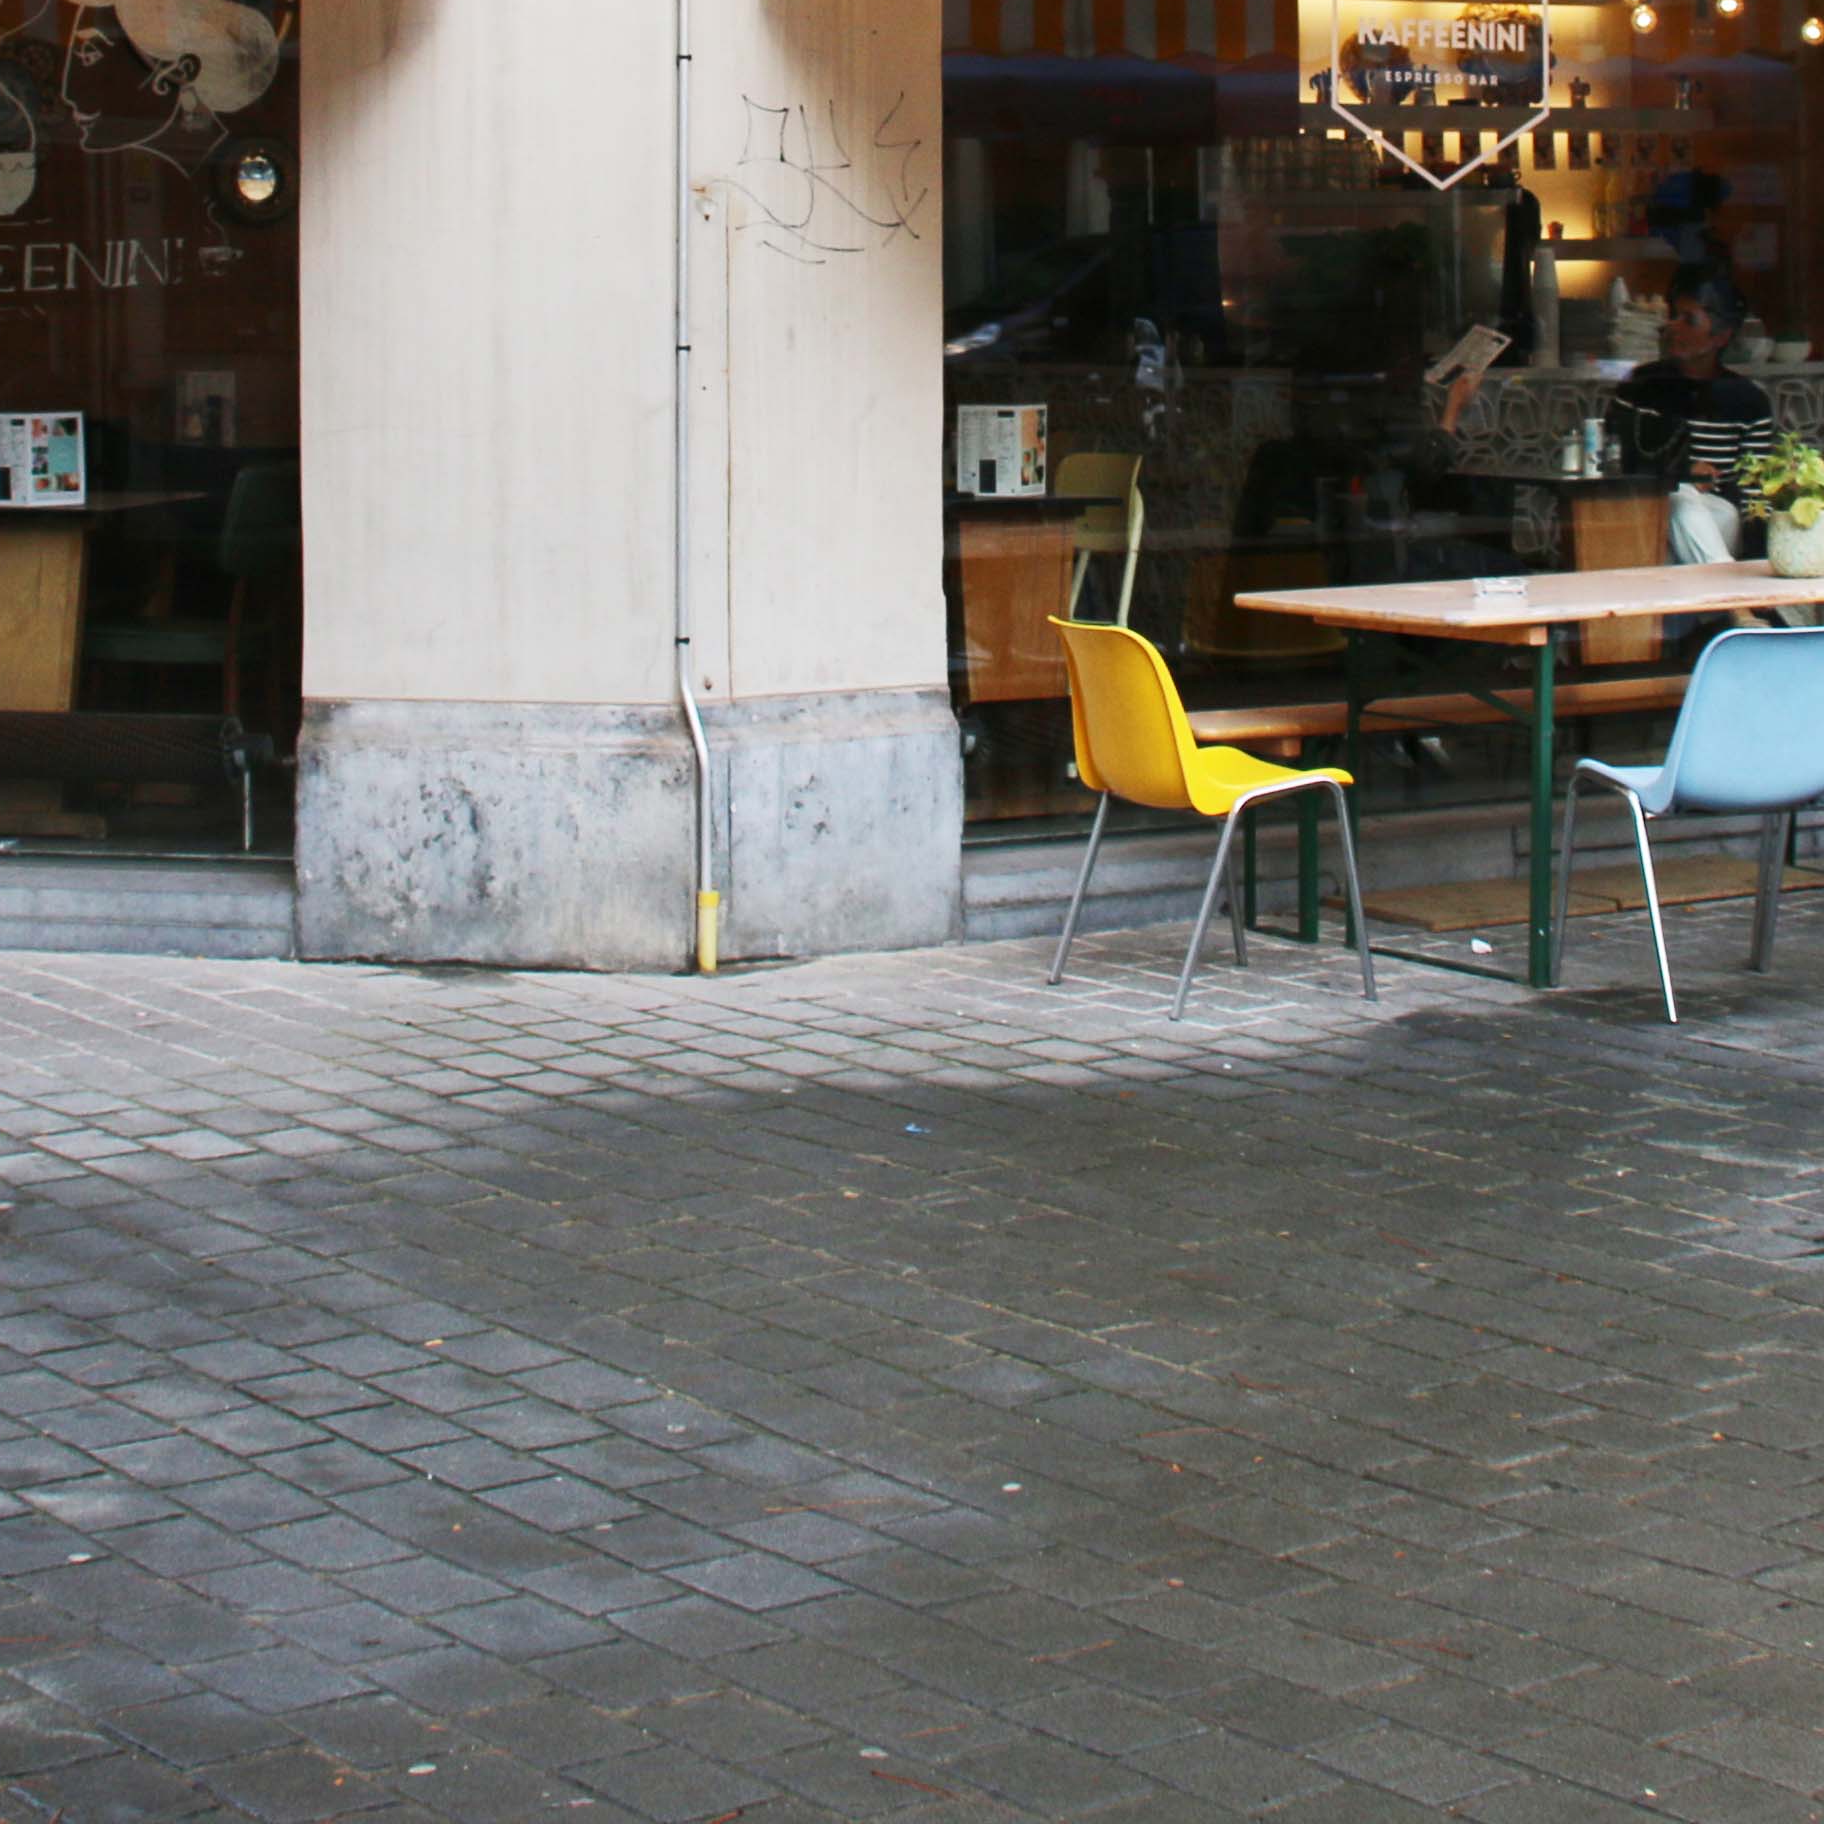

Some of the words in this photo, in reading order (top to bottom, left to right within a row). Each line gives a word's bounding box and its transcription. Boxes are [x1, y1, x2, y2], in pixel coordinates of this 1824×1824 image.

[1357, 17, 1526, 52] KAFFEENINI
[1384, 70, 1462, 86] ESPRESSO
[1469, 75, 1499, 87] BAR
